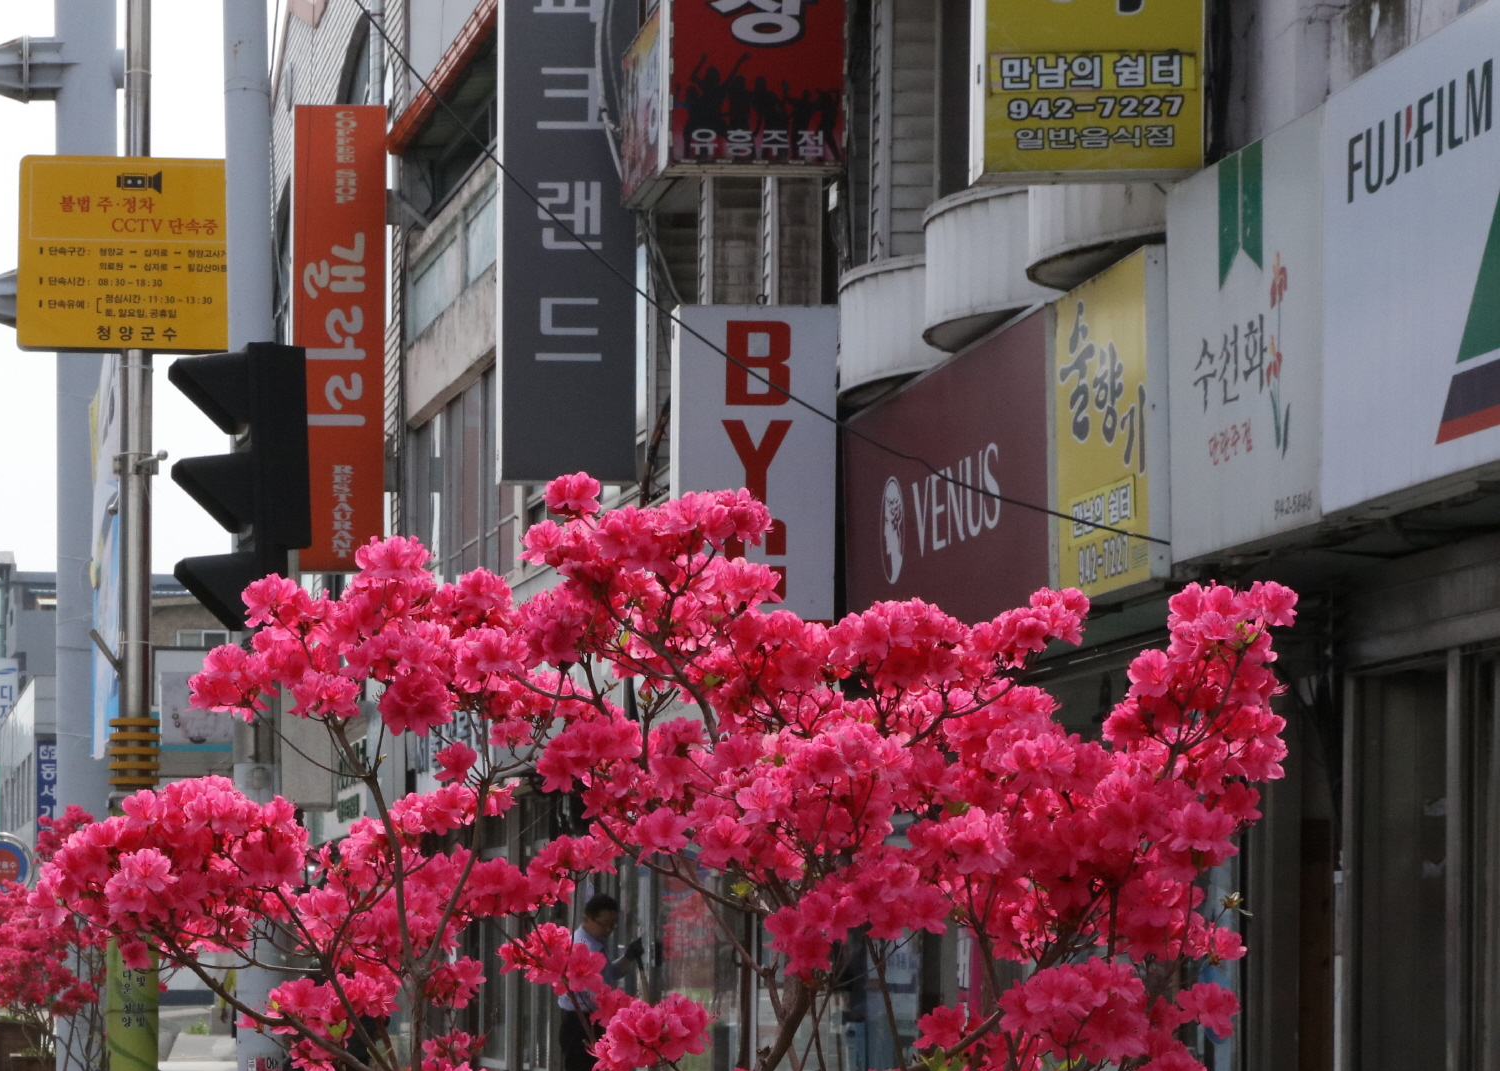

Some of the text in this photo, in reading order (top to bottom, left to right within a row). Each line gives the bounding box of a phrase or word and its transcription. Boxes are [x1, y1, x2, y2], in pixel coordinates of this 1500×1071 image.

[1000, 53, 1183, 91] 만남의 쉼터
[1008, 95, 1184, 121] 942-7227
[690, 128, 825, 158] 유흥주점
[1015, 125, 1176, 151] 일반음식점
[1347, 57, 1494, 205] FUJIFILM
[334, 110, 357, 204] COFFEE SHOP
[59, 195, 91, 213] 불법
[112, 218, 219, 236] CCTV 단속중
[97, 326, 178, 341] 청양군수
[1193, 313, 1268, 415] 수선화
[1059, 300, 1147, 475] 술향기
[332, 464, 354, 558] RESTAURANT
[911, 442, 1002, 560] VENUS
[1072, 494, 1106, 540] 만남의
[1078, 534, 1130, 588] 942-7227
[121, 1003, 132, 1028] 청양
